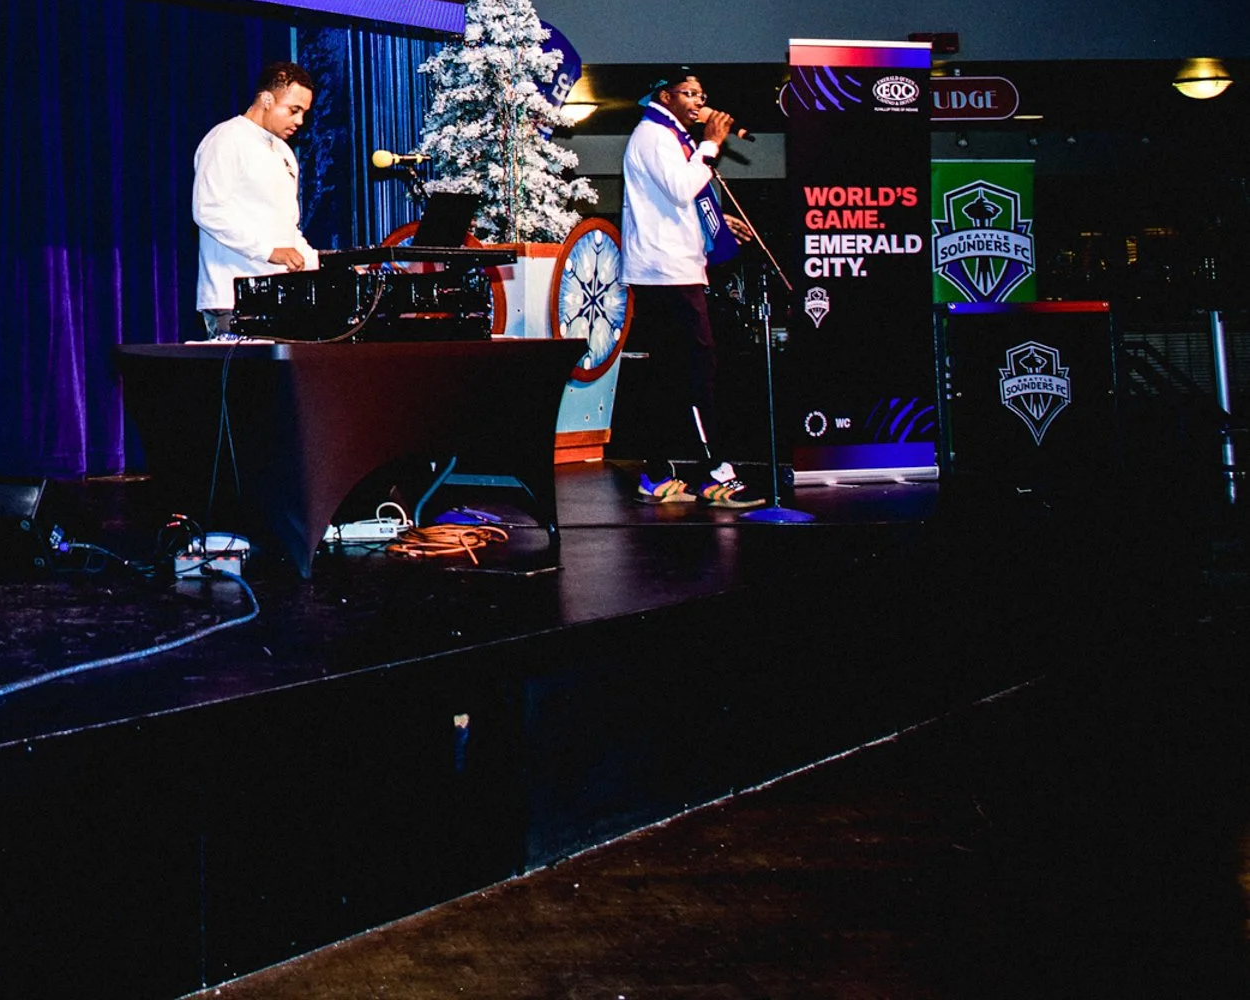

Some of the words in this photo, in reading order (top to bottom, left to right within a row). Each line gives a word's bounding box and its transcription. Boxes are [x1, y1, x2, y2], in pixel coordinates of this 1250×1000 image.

[881, 83, 914, 100] EQC
[931, 90, 999, 109] UDGE
[804, 186, 918, 207] WORLD'S
[805, 209, 886, 230] GAME.
[804, 234, 923, 254] EMERALD
[958, 233, 1010, 242] SEATTLE
[940, 240, 1011, 261] SOUNDERS
[1014, 244, 1030, 261] FC
[803, 256, 868, 278] CITY.
[1006, 381, 1054, 395] SOUNDERS
[1056, 386, 1066, 395] FC
[835, 418, 851, 428] WC
